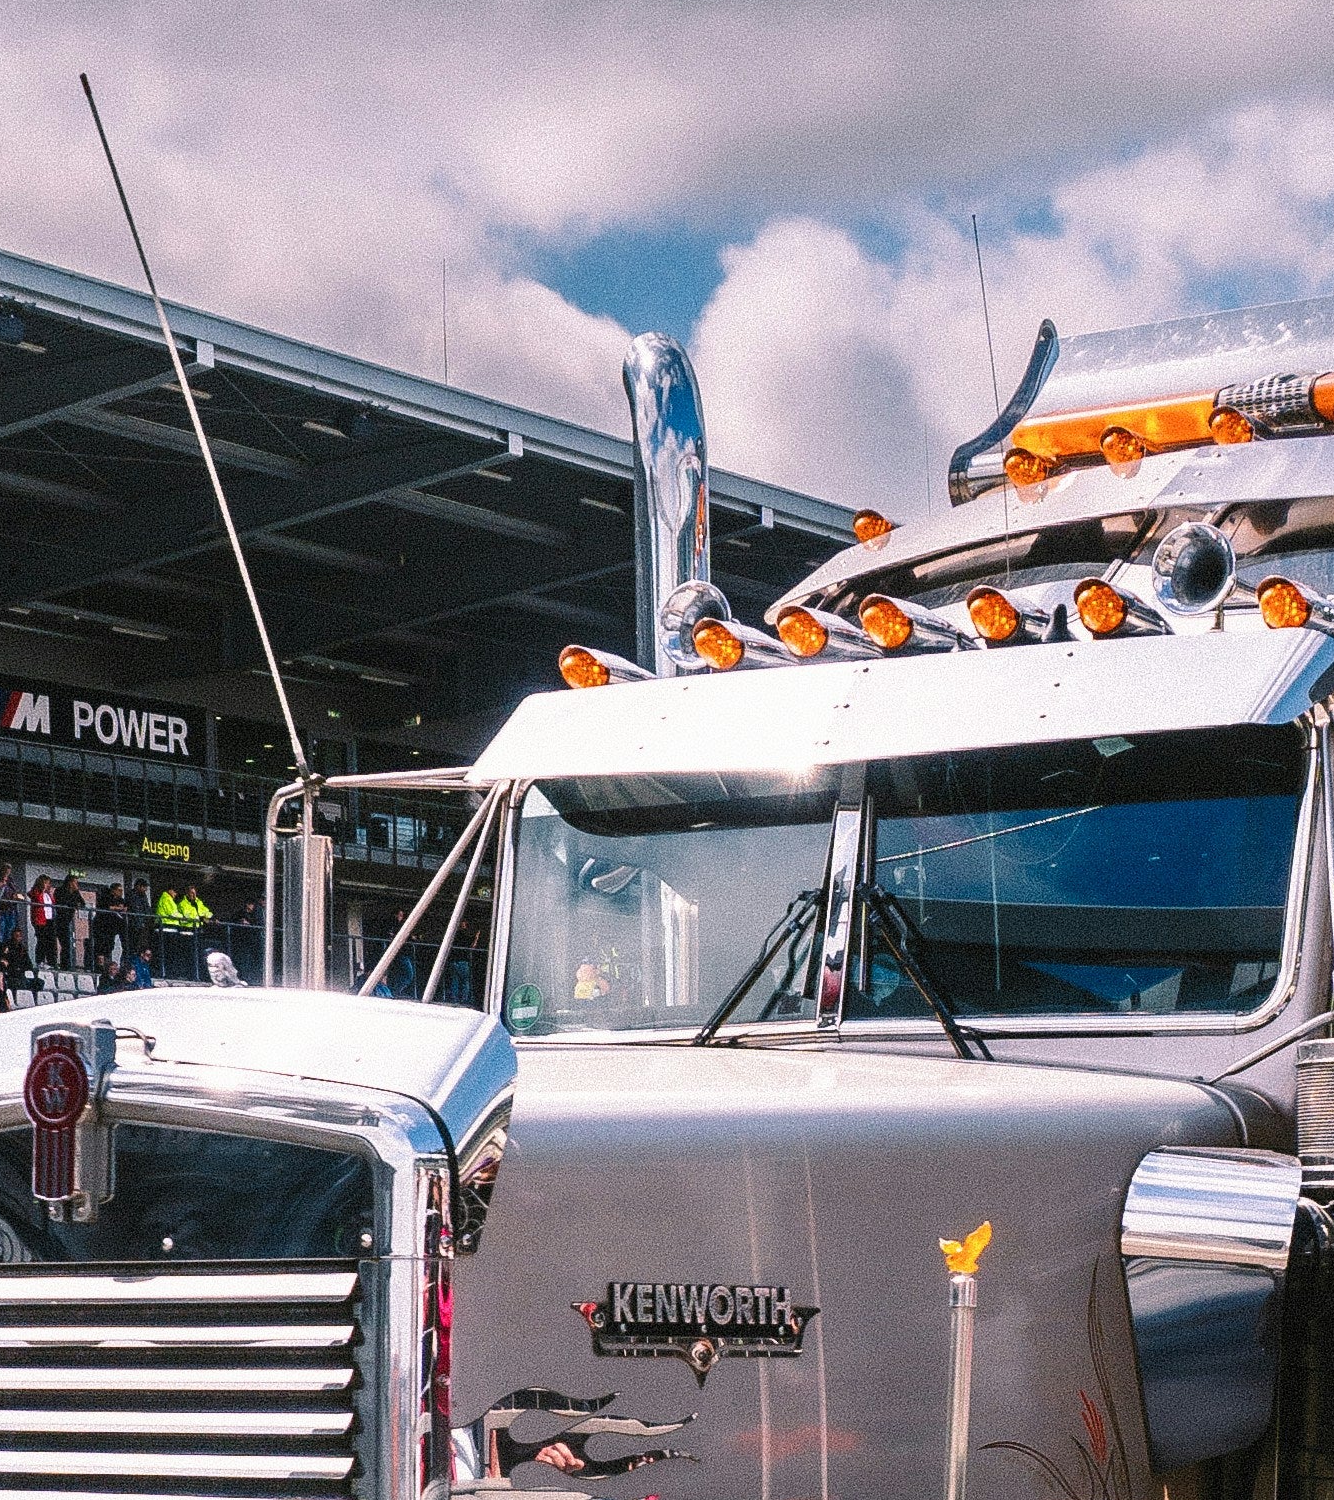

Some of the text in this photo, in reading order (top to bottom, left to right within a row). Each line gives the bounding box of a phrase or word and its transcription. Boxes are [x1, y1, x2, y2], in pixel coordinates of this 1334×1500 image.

[73, 699, 190, 756] POWER
[142, 836, 190, 862] Ausgang
[611, 1282, 794, 1328] KENWORTH
